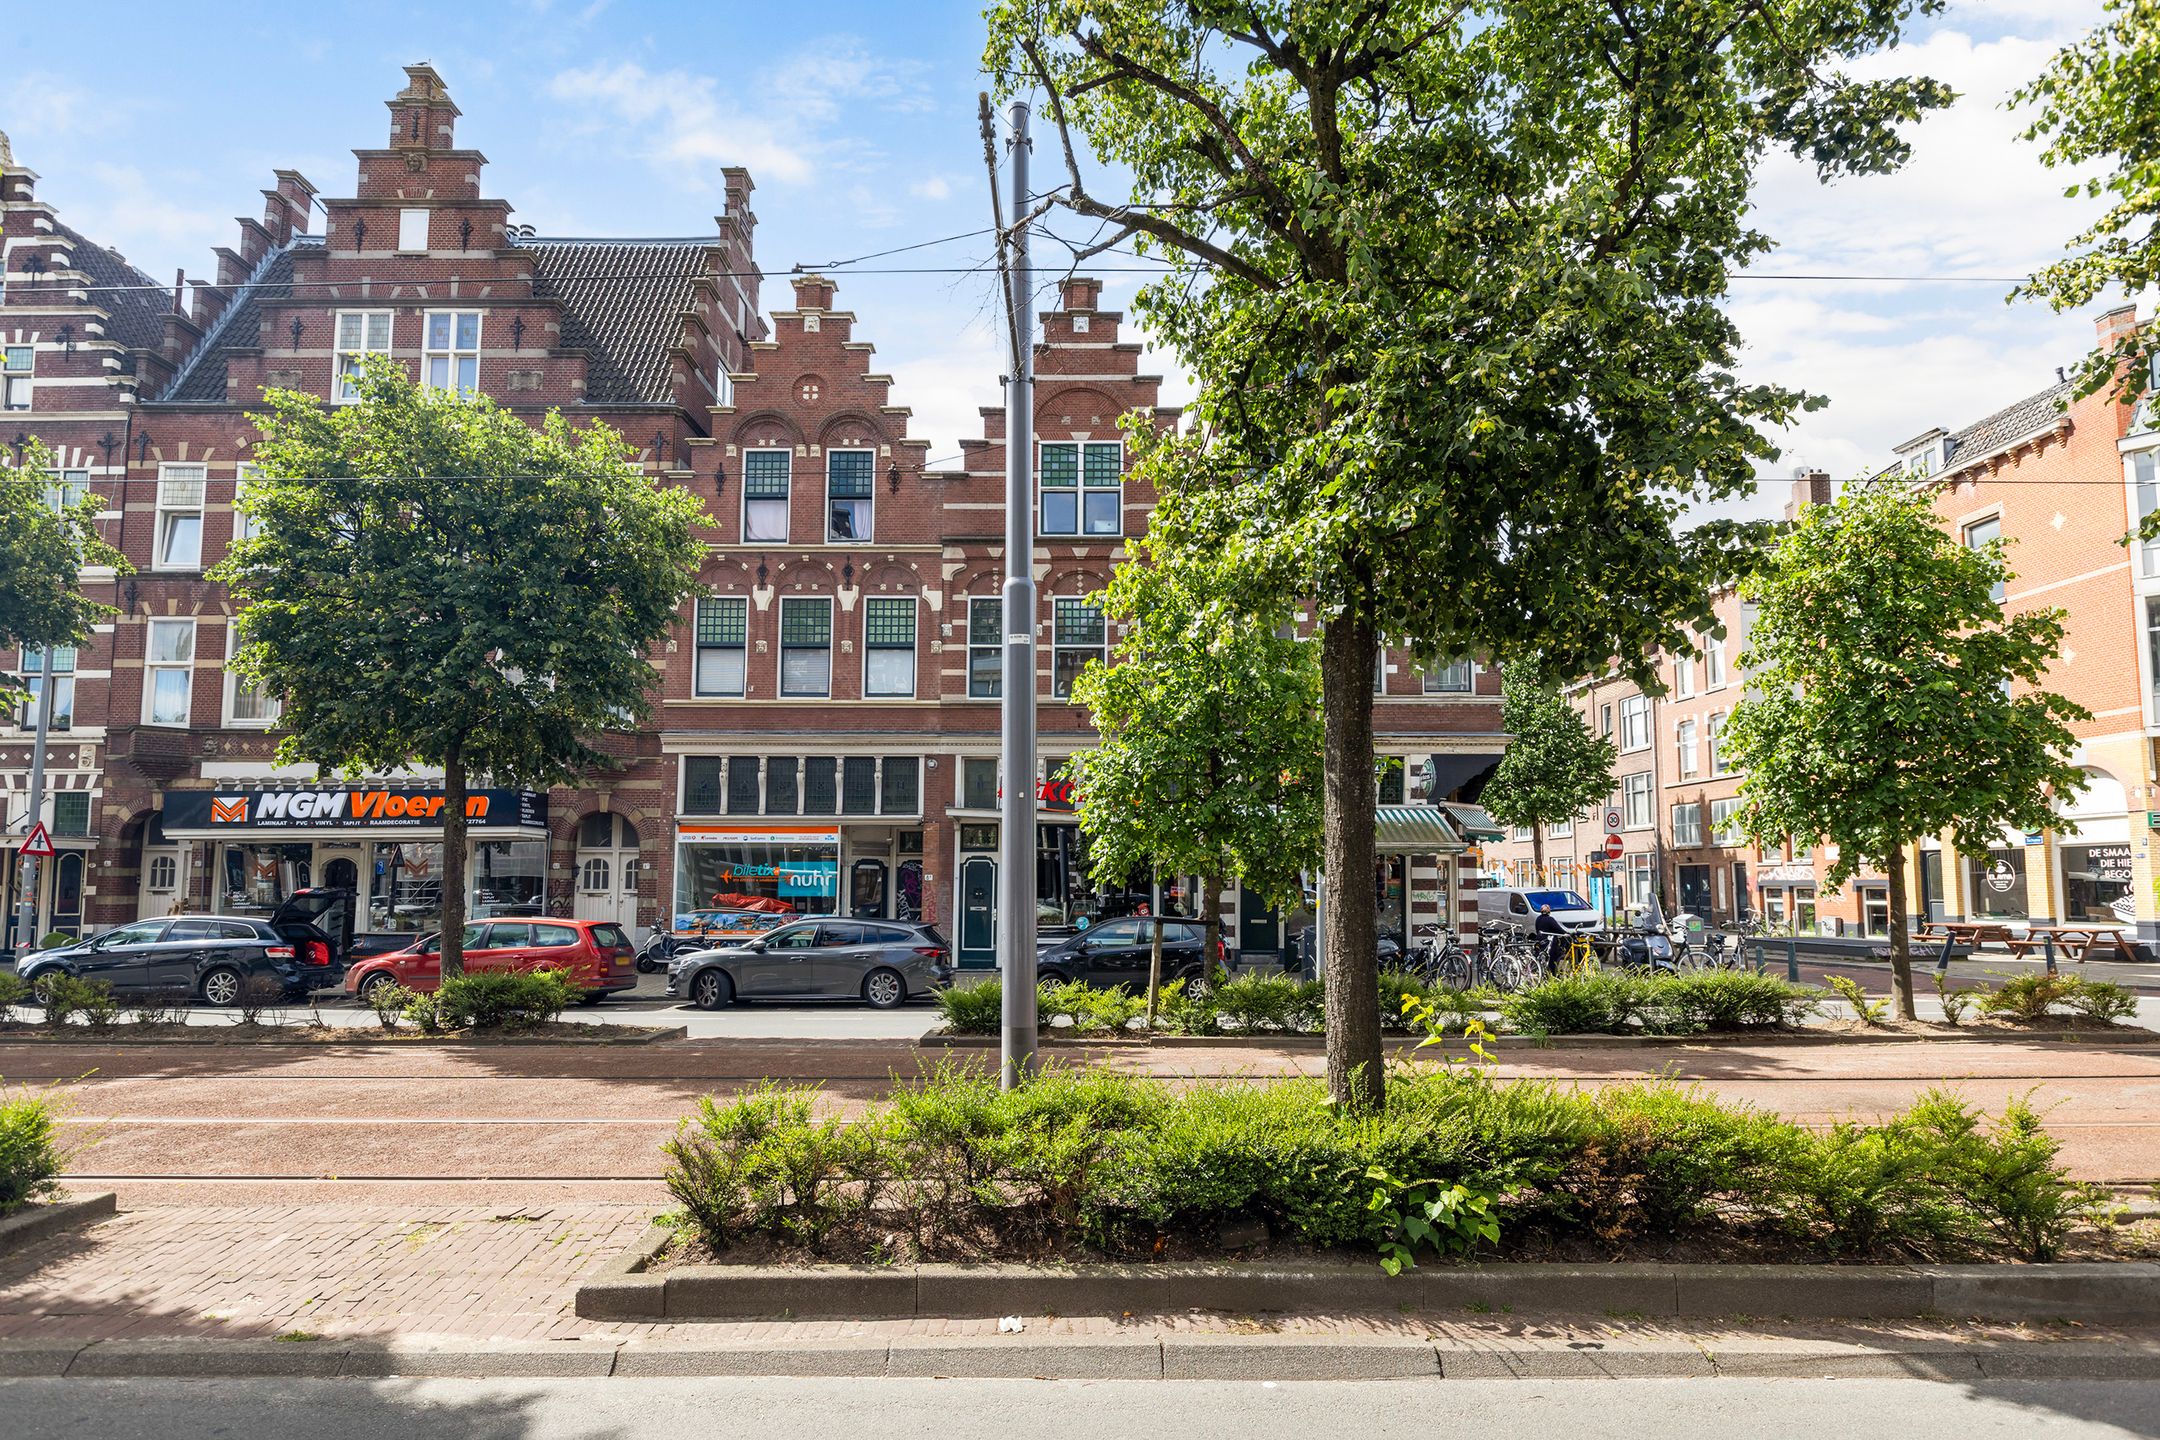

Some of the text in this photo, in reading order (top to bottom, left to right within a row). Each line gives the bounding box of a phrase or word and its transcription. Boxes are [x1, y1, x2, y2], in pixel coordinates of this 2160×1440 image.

[255, 791, 490, 819] MGM Vloern
[2088, 848, 2131, 857] DE SMAA
[2100, 858, 2132, 867] DIE HIE
[733, 862, 776, 876] biletix
[2104, 870, 2132, 878] BEGO
[791, 869, 832, 886] nuhr
